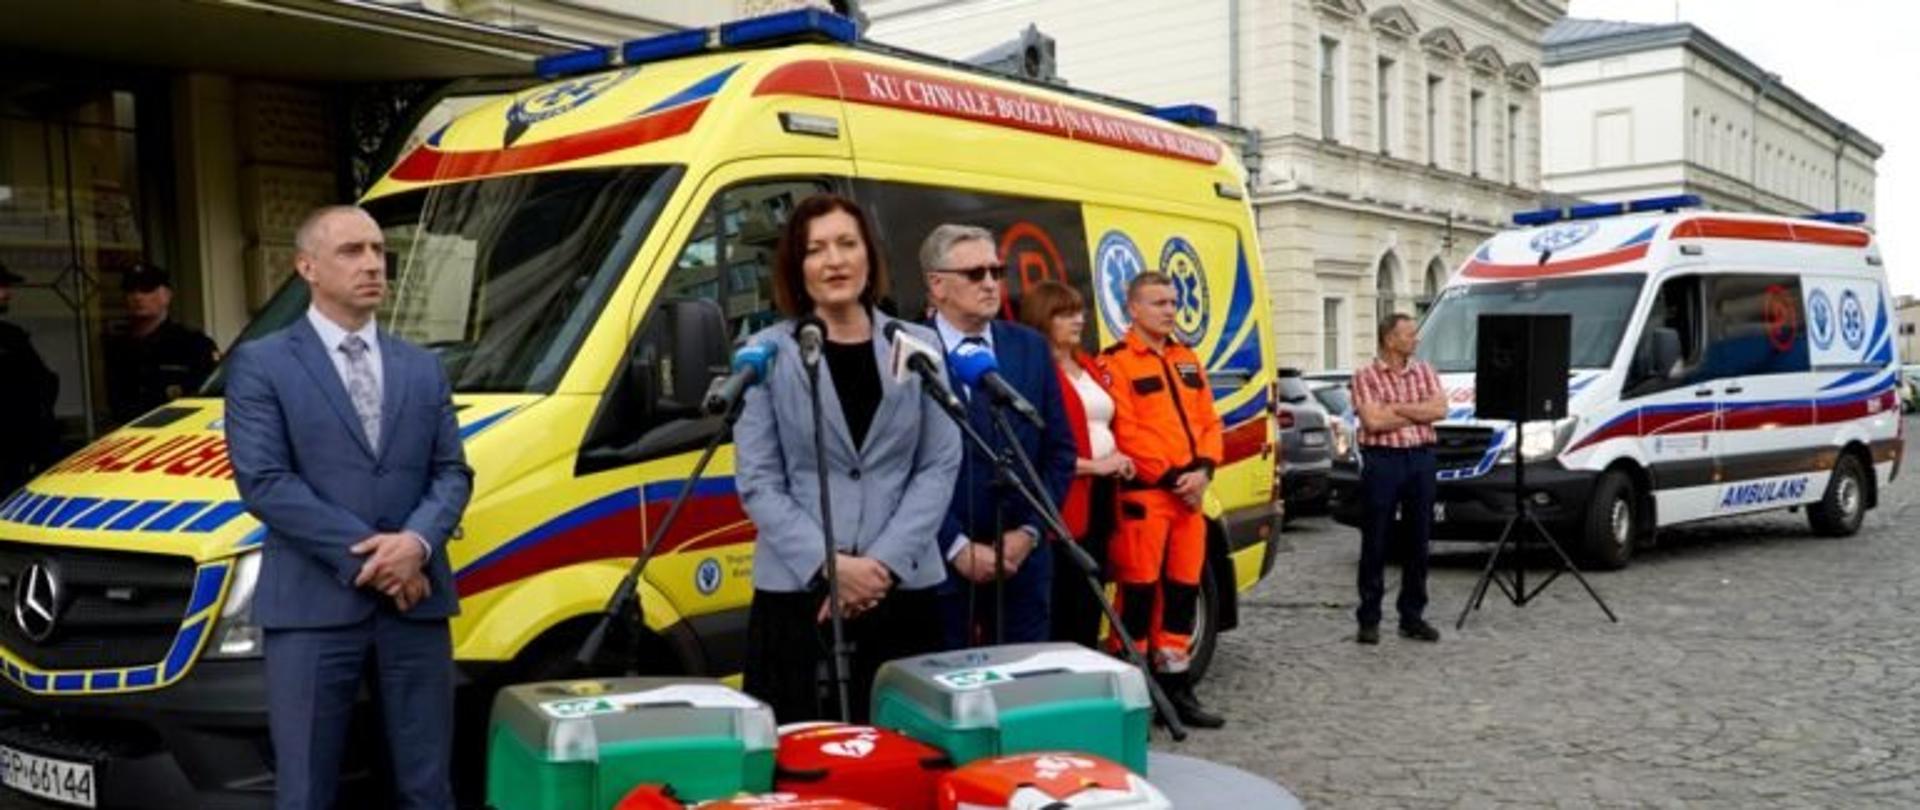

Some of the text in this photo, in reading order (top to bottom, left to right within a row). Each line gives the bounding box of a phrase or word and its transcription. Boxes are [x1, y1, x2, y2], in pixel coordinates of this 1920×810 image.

[863, 72, 901, 101] KU
[904, 79, 995, 117] CHWALE
[1720, 477, 1809, 508] AMBULANS
[30, 758, 92, 802] 66144
